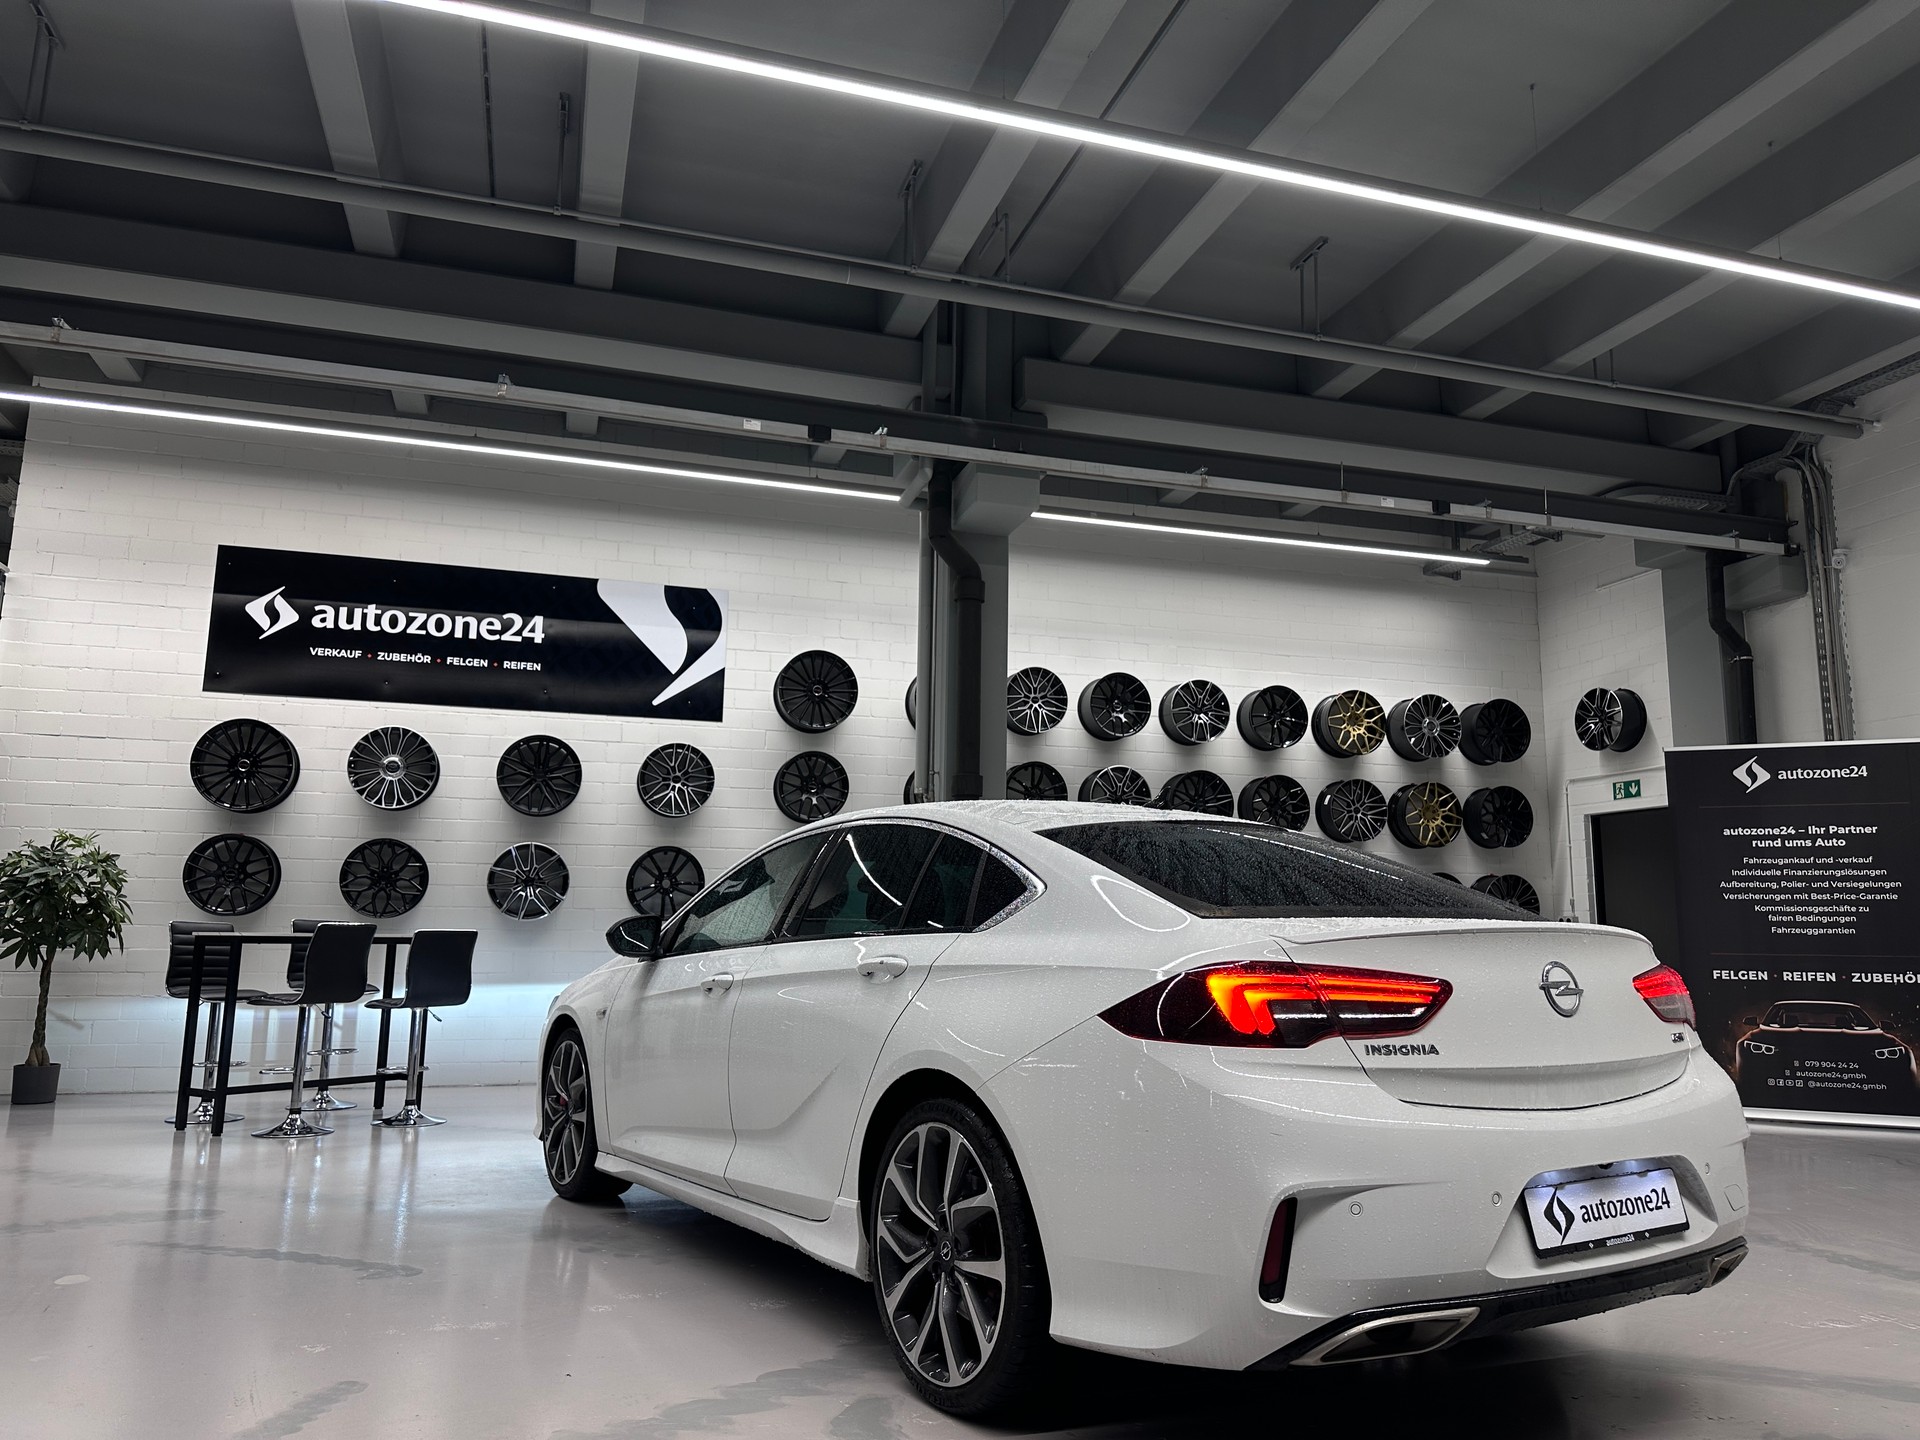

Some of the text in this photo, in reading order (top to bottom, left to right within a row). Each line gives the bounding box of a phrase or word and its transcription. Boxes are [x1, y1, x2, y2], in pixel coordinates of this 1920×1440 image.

[311, 603, 546, 644] autozone24
[309, 646, 542, 672] VERKAUF ZUBEHÖR FELGEN REIFEN
[1777, 765, 1868, 780] autozone24
[1722, 825, 1797, 836] autozone24
[1807, 825, 1826, 835] Ihr
[1828, 825, 1878, 835] Partner
[1751, 837, 1847, 848] rund ums Auto
[1743, 855, 1873, 866] Fahrzeugankauf und -verkauf
[1731, 868, 1888, 878] Individuelle Finanzierungslösungen
[1719, 880, 1902, 890] Aufbereitung, Polier- und Versiegelungen
[1722, 892, 1899, 902] Versicherungen mit Best-Price-Garantie
[1754, 904, 1857, 914] Kommissionsgeschäfte
[1768, 913, 1857, 924] fairen Bedingungen
[1771, 926, 1856, 936] Fahrzeuggarantien
[1712, 969, 1768, 981] FELGEN
[1782, 971, 1837, 982] REIFEN
[1364, 1044, 1440, 1056] INSIGNIA
[1804, 1060, 1820, 1068] 079
[1837, 1061, 1848, 1069] 24
[1795, 1070, 1867, 1079] autozone24.gmbh
[1807, 1080, 1887, 1091] @autozone24.gmbh
[1580, 1187, 1671, 1224] autozone24
[1606, 1233, 1635, 1247] autozone24
